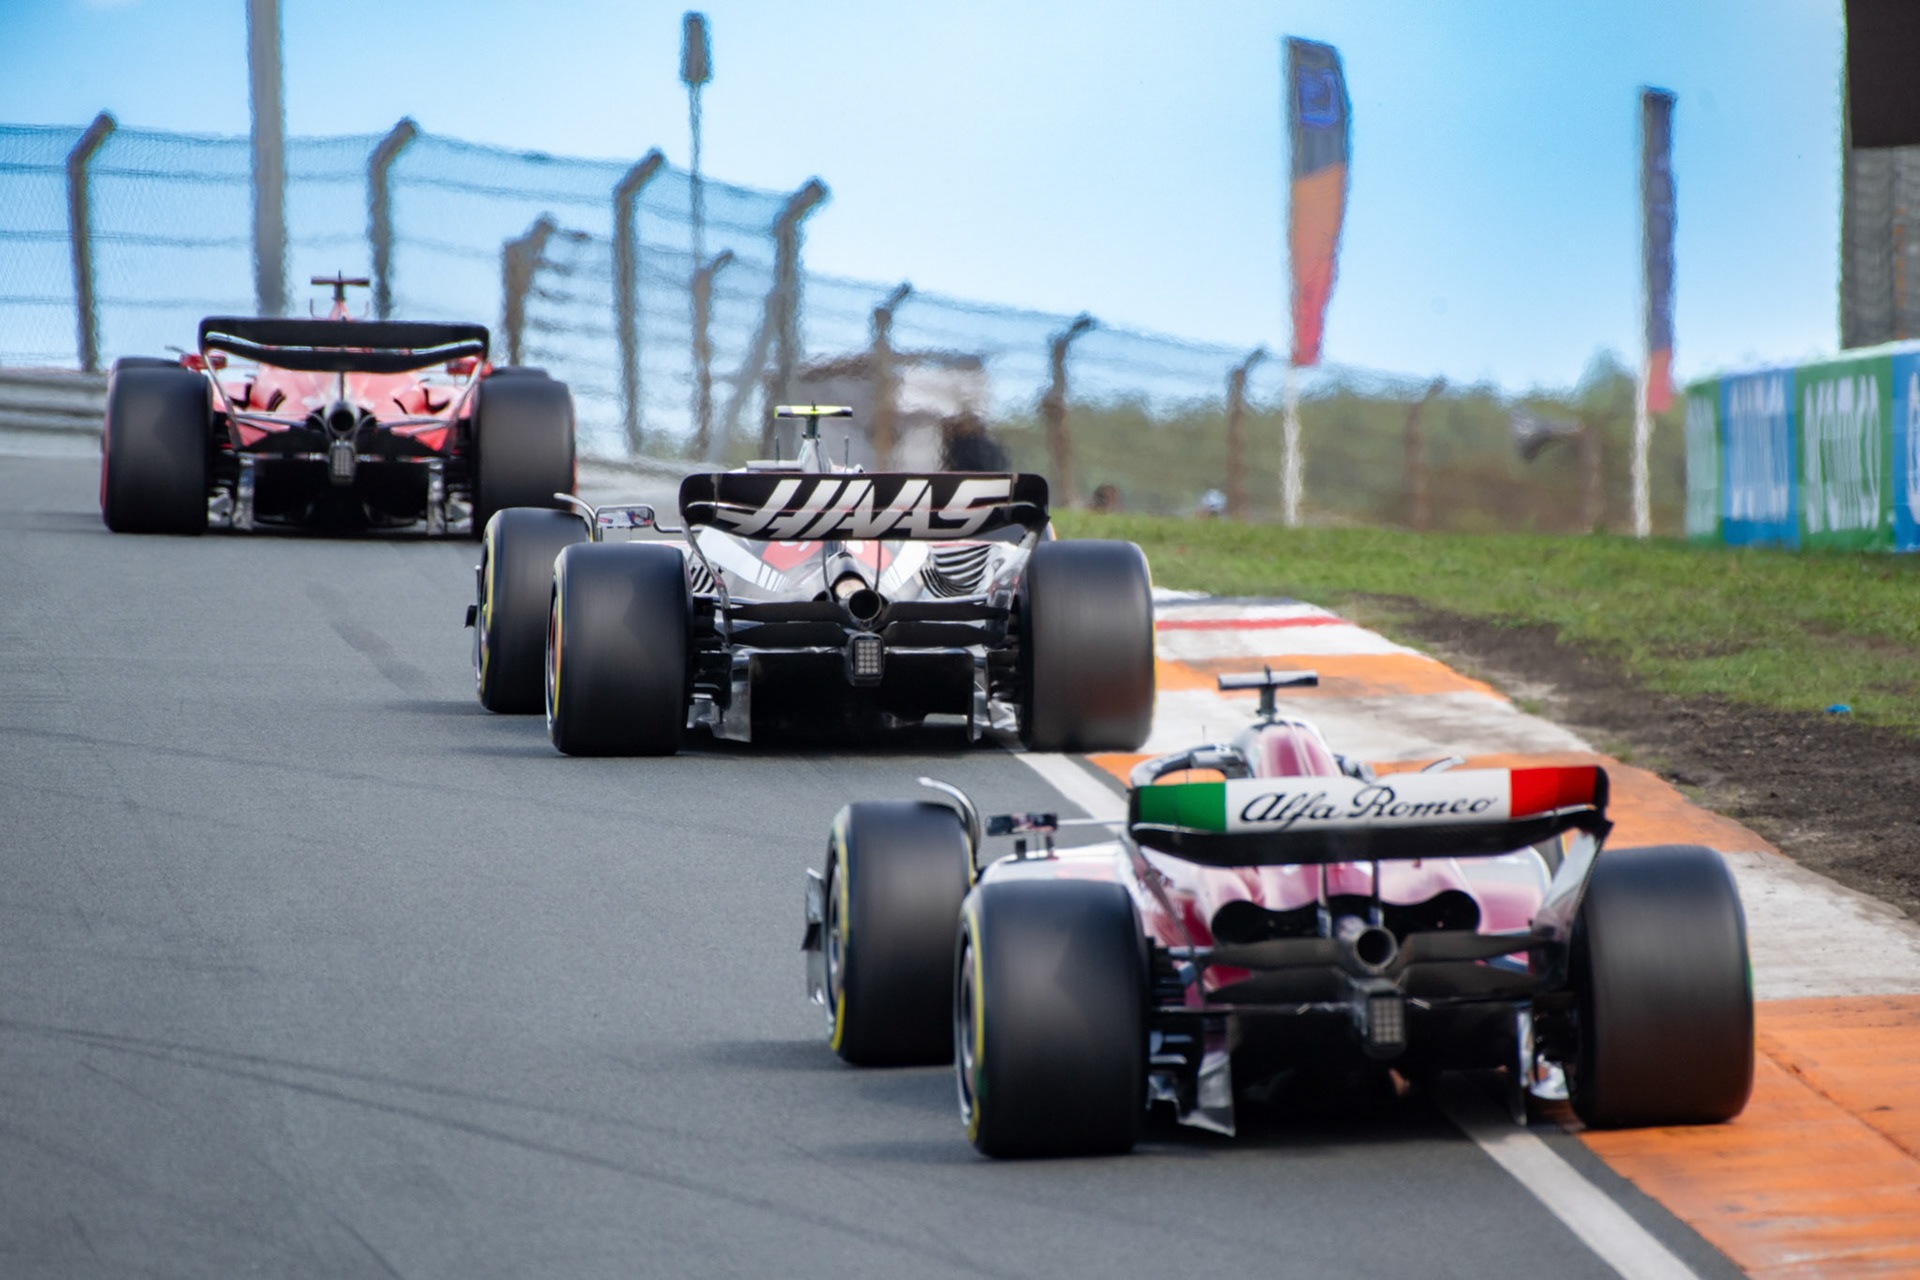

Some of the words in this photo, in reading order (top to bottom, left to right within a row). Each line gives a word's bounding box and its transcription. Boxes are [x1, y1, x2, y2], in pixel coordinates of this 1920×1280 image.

[716, 479, 1011, 538] HAAS
[1240, 792, 1340, 829] Alfa
[1345, 785, 1498, 819] Romeo
